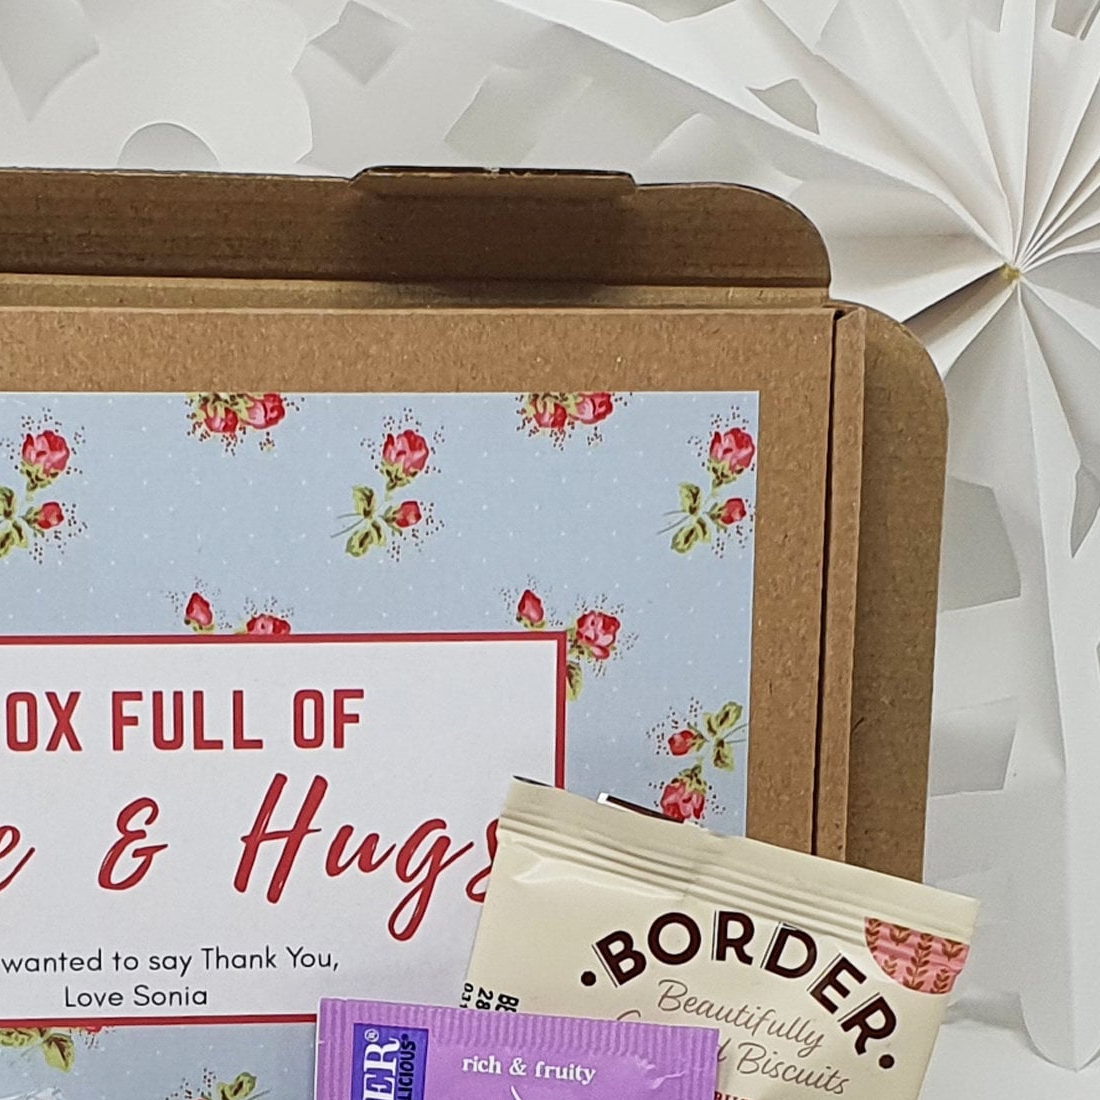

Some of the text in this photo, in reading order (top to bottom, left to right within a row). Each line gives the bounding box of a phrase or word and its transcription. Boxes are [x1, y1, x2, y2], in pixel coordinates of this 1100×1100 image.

[111, 690, 264, 752] FULL
[293, 688, 365, 750] OF
[99, 796, 169, 891] &
[1, 947, 101, 973] wanted
[112, 949, 140, 971] to
[148, 953, 192, 977] say
[200, 945, 277, 971] Thank
[286, 945, 340, 972] You,
[64, 984, 209, 1008] Love Sonia
[657, 979, 826, 1058] Beautifully
[461, 1055, 597, 1086] rich & fruity
[736, 1042, 850, 1096] Biscuits
